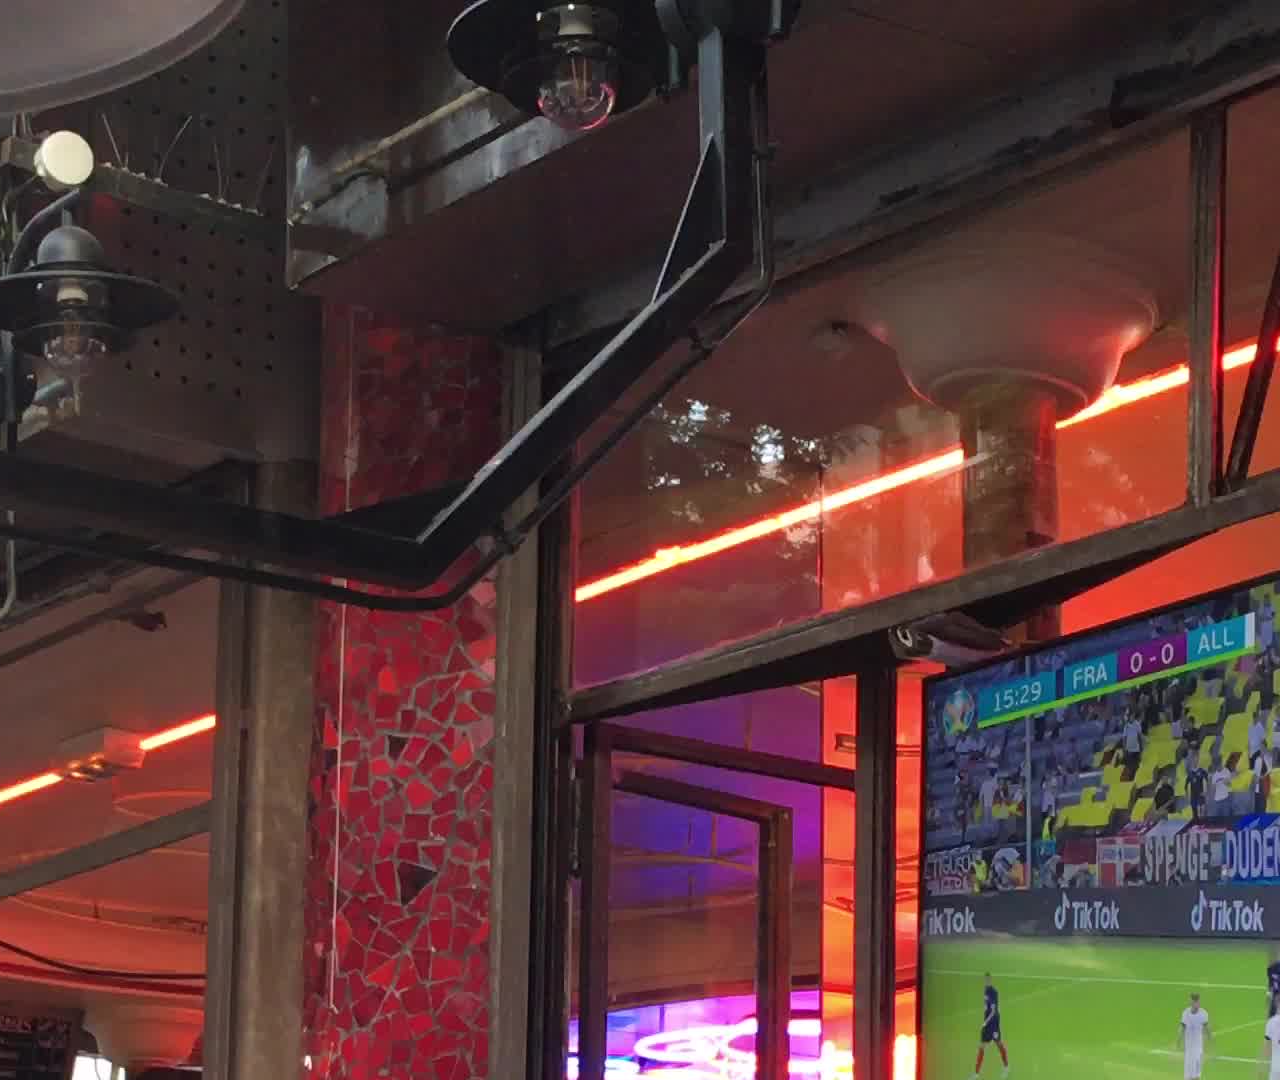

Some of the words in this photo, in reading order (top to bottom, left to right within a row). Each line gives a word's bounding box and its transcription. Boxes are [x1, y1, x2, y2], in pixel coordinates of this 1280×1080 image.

[1197, 629, 1235, 655] ALL
[1072, 663, 1109, 690] FRA
[993, 681, 1042, 713] 15:29
[1071, 900, 1120, 929] TikTok
[1208, 900, 1264, 931] TikTok
